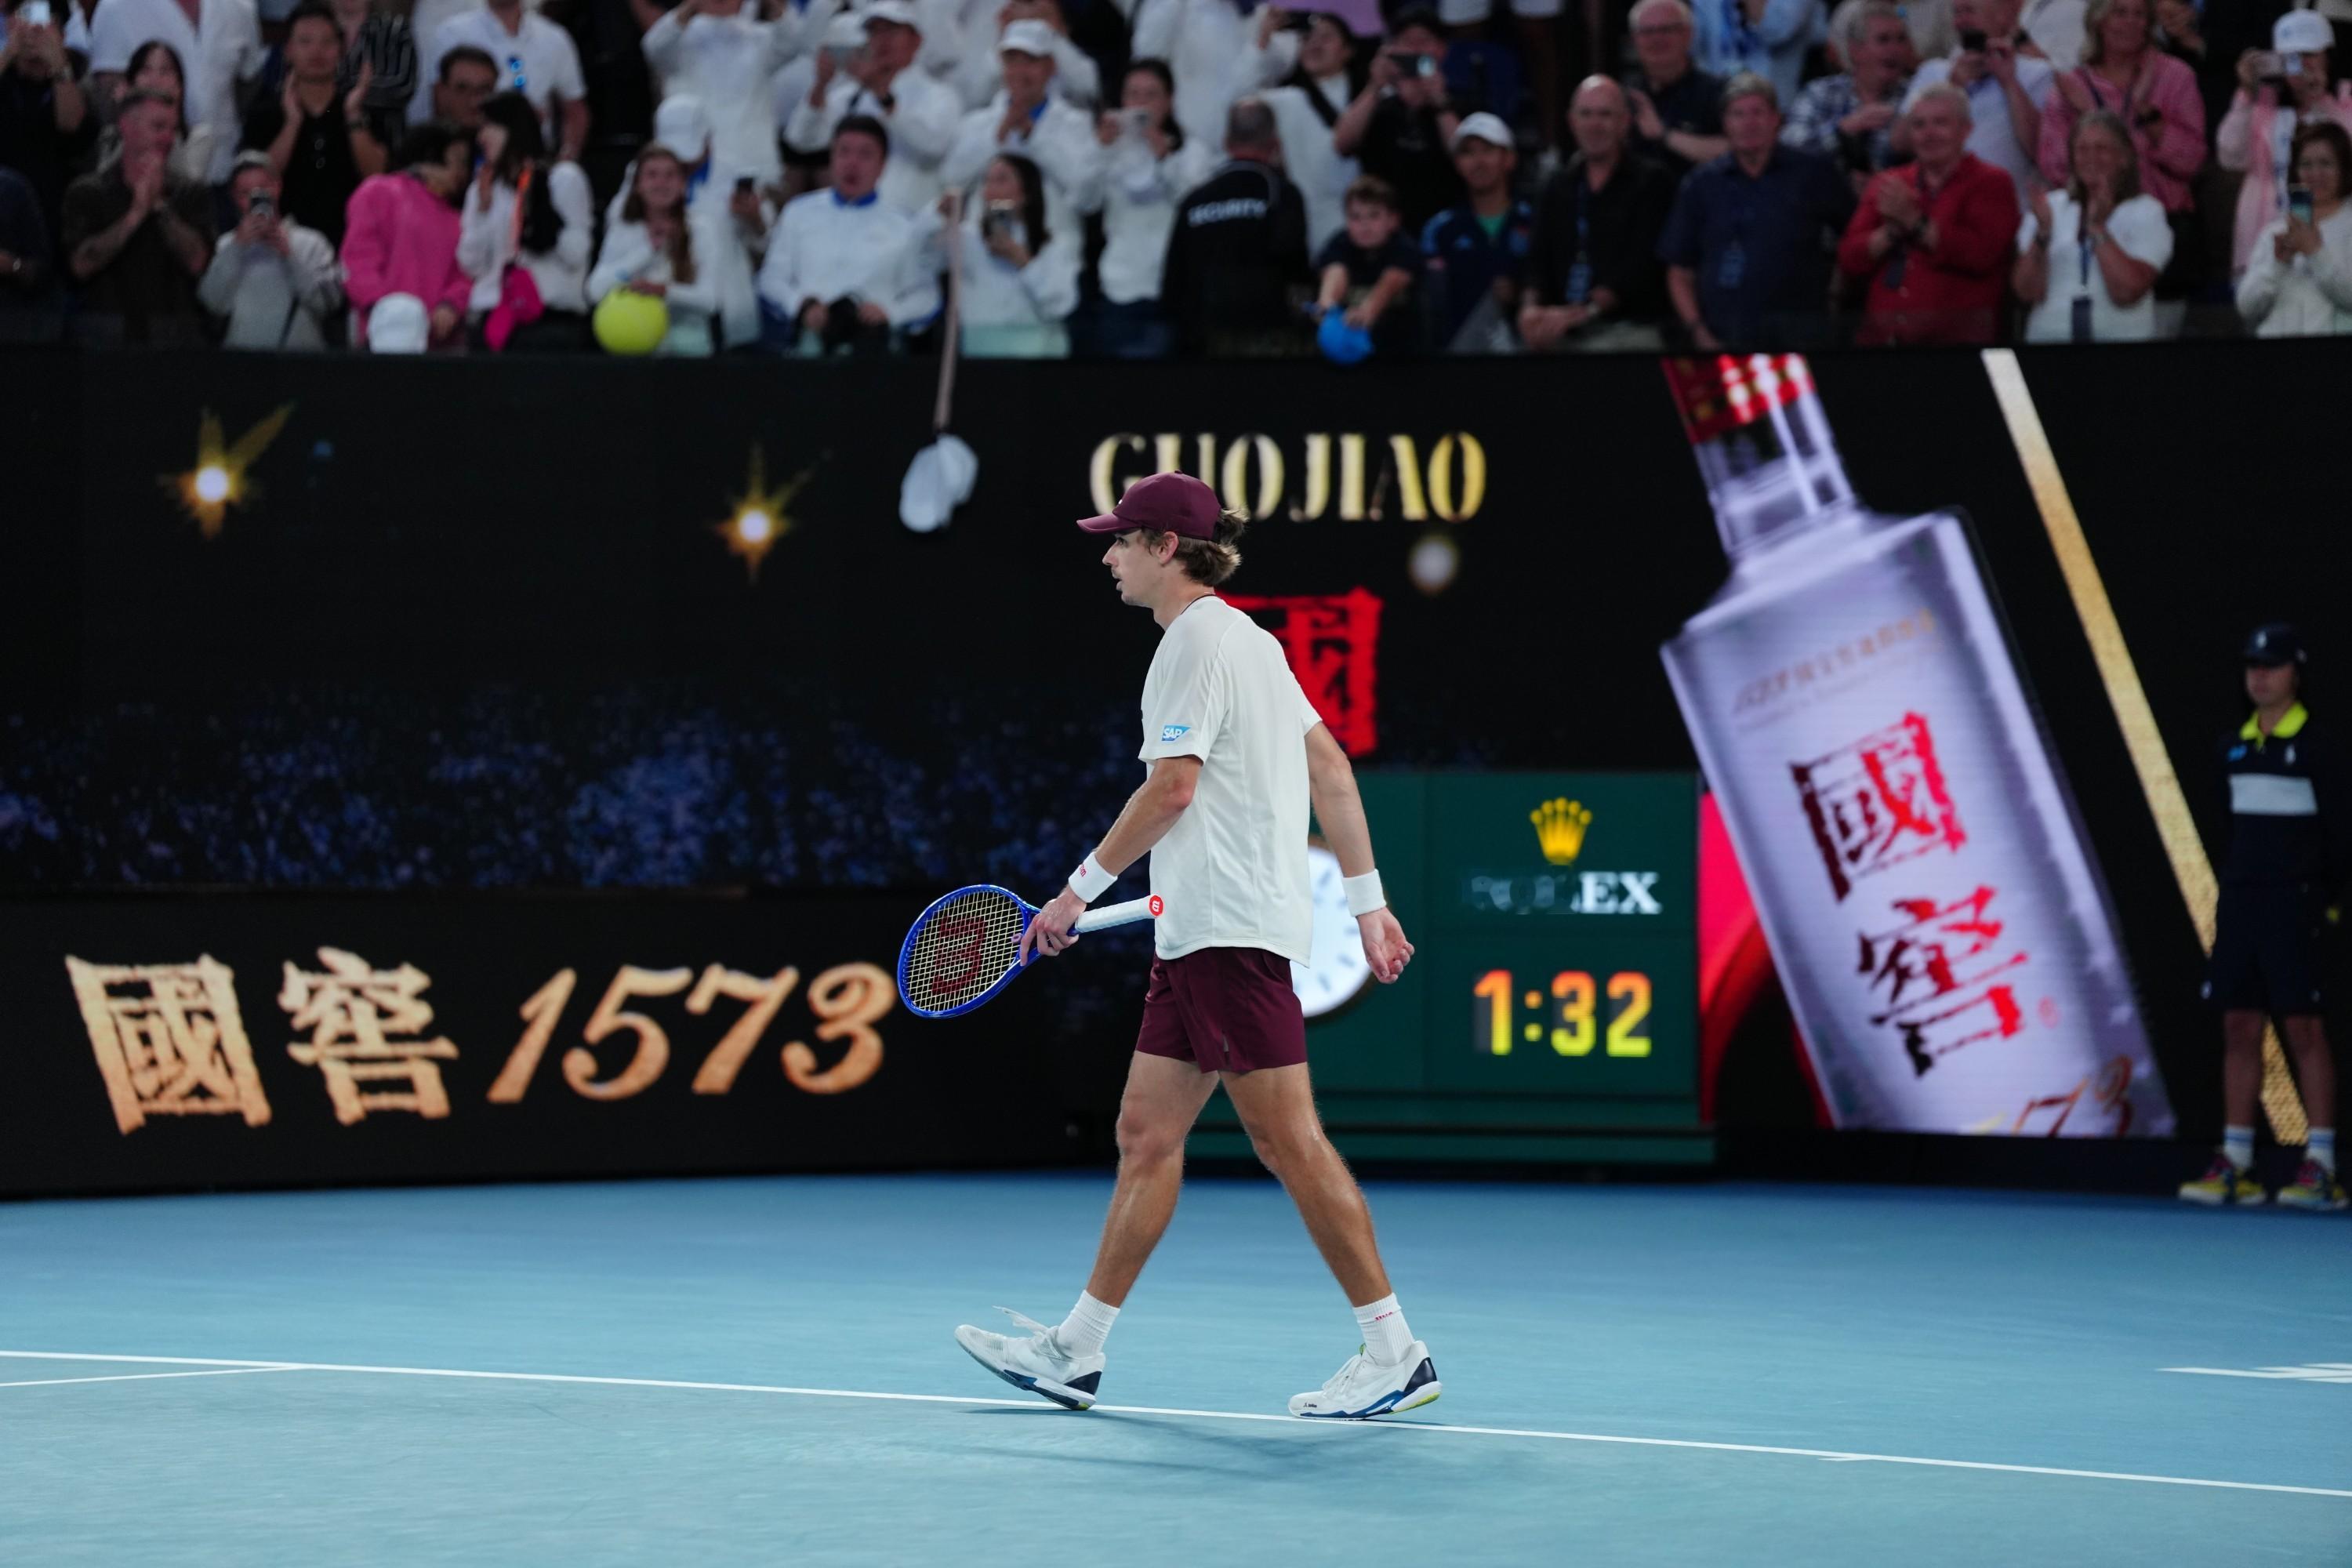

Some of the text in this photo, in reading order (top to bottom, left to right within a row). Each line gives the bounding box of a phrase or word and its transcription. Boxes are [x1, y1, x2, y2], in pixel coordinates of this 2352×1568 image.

[64, 946, 896, 1134] 國窖 1573
[1473, 968, 1653, 1058] 1:32
